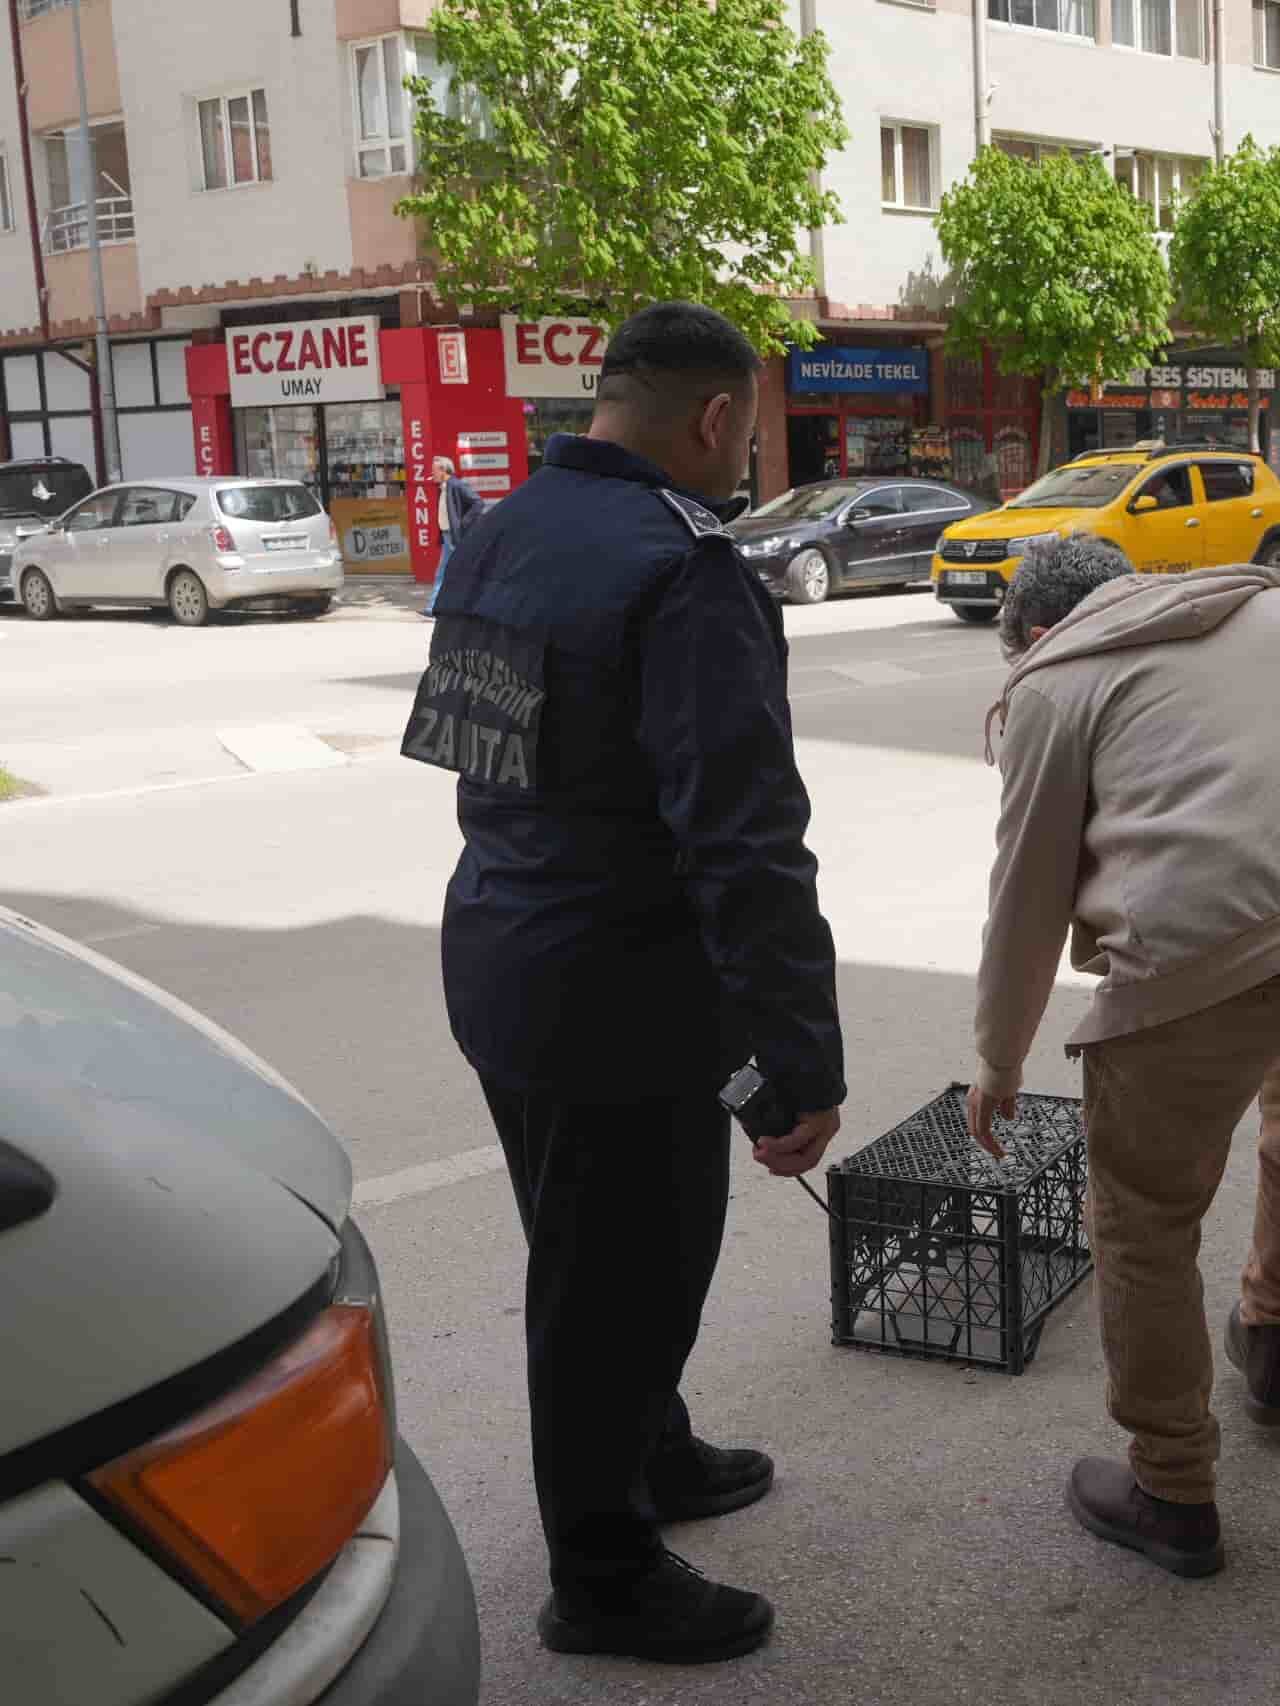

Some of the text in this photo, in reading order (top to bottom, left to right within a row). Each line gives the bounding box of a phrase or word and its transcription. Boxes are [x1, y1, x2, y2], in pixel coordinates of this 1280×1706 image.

[232, 324, 369, 375] ECZANE
[515, 323, 604, 366] ECZ
[281, 377, 322, 396] UMAY
[801, 360, 920, 380] NEVİZADE TEKEL
[1151, 366, 1182, 387] SES
[199, 426, 214, 479] ECZ
[410, 420, 430, 546] ECZANE
[405, 705, 529, 789] ZAITA
